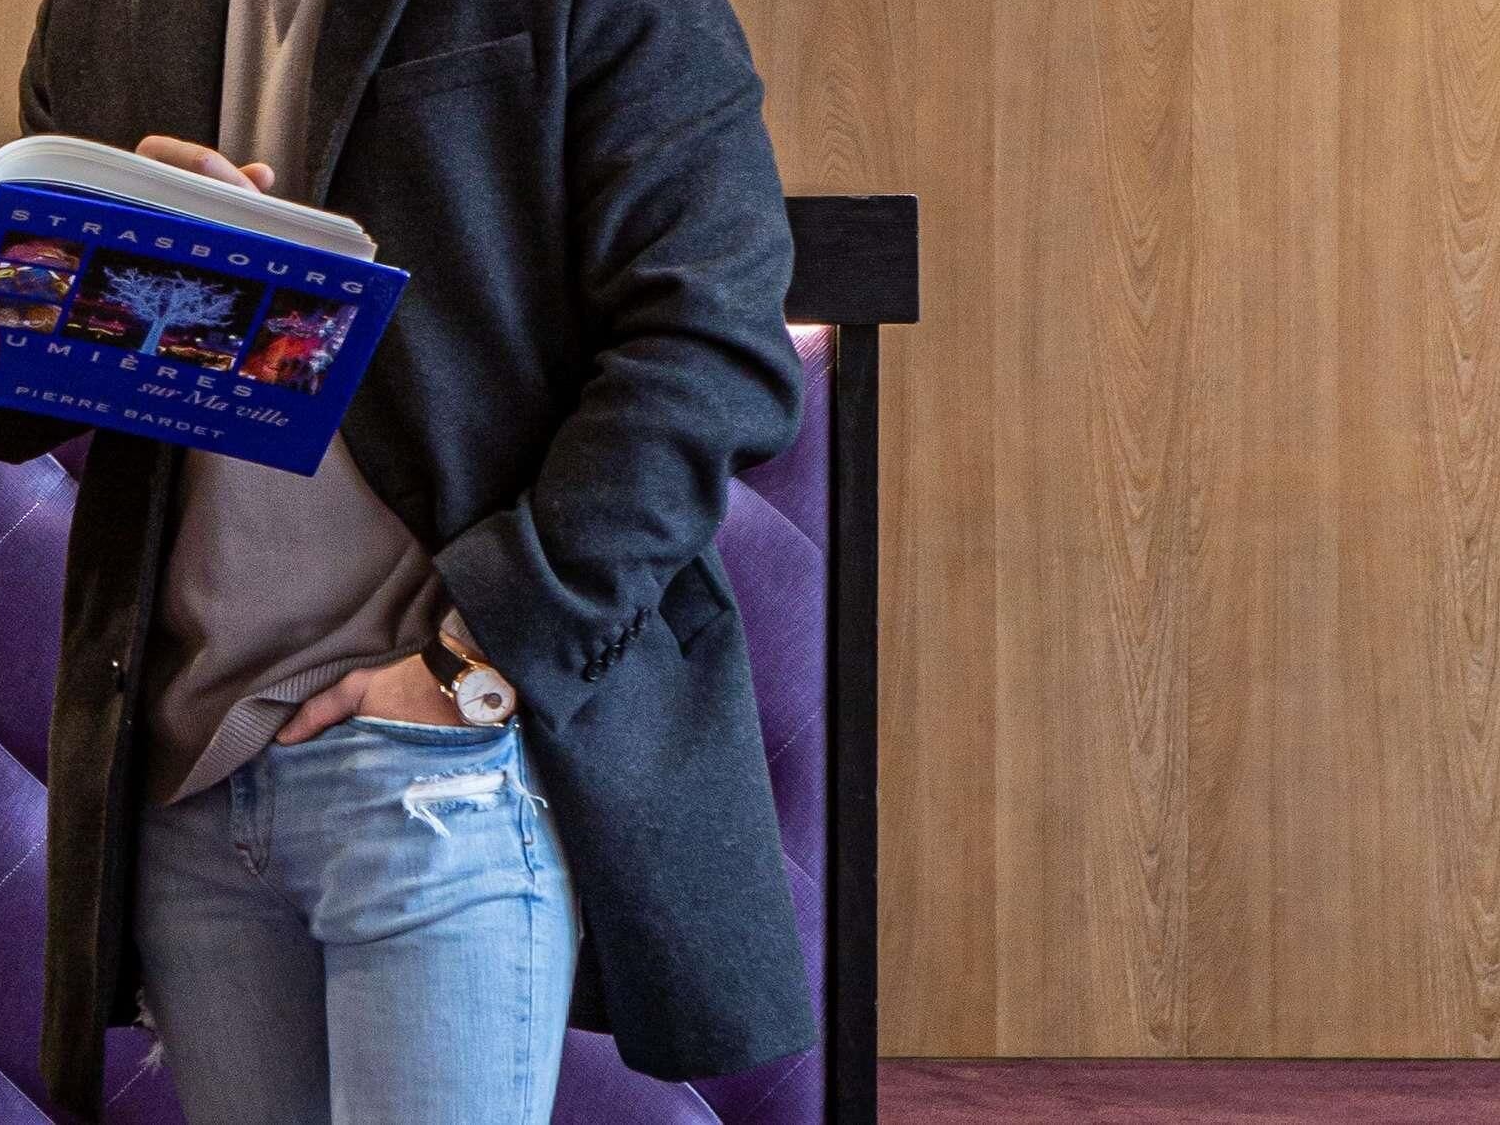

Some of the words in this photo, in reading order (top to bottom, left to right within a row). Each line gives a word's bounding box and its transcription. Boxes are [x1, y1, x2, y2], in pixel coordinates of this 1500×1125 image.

[10, 208, 366, 296] STRASBOURG
[4, 334, 255, 399] UMIÈRES
[15, 385, 110, 414] PIERRE
[123, 408, 227, 440] BARDET
[137, 381, 181, 398] sur
[183, 389, 230, 413] Ma
[235, 404, 290, 428] ville
